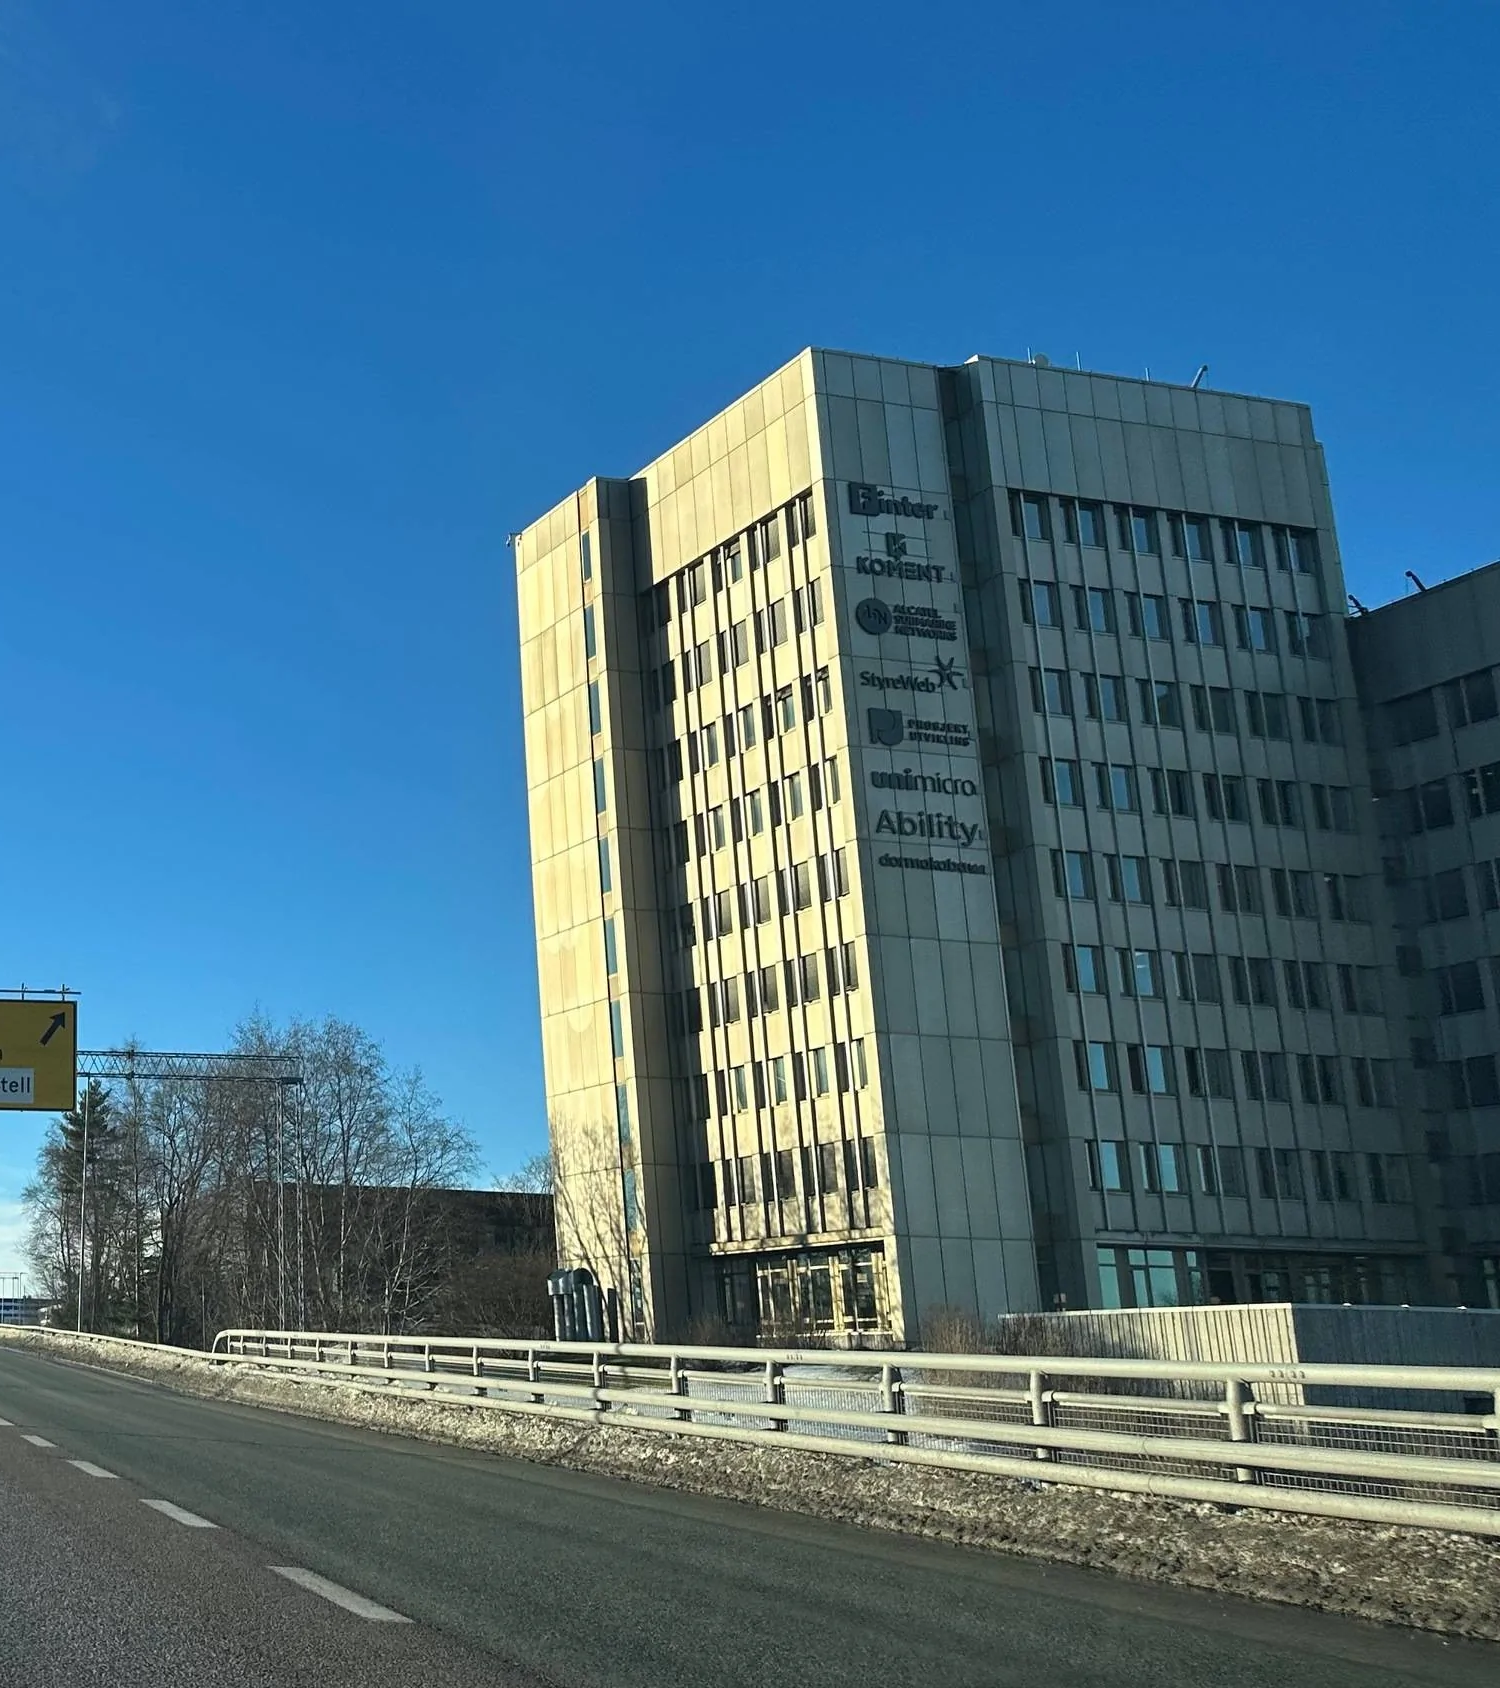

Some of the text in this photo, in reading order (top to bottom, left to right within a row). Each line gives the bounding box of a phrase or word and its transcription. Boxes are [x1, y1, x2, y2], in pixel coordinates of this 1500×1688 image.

[856, 556, 946, 583] KOMENT
[860, 670, 936, 693] StyreWeb
[871, 768, 978, 797] unimicro
[875, 809, 978, 847] Ability
